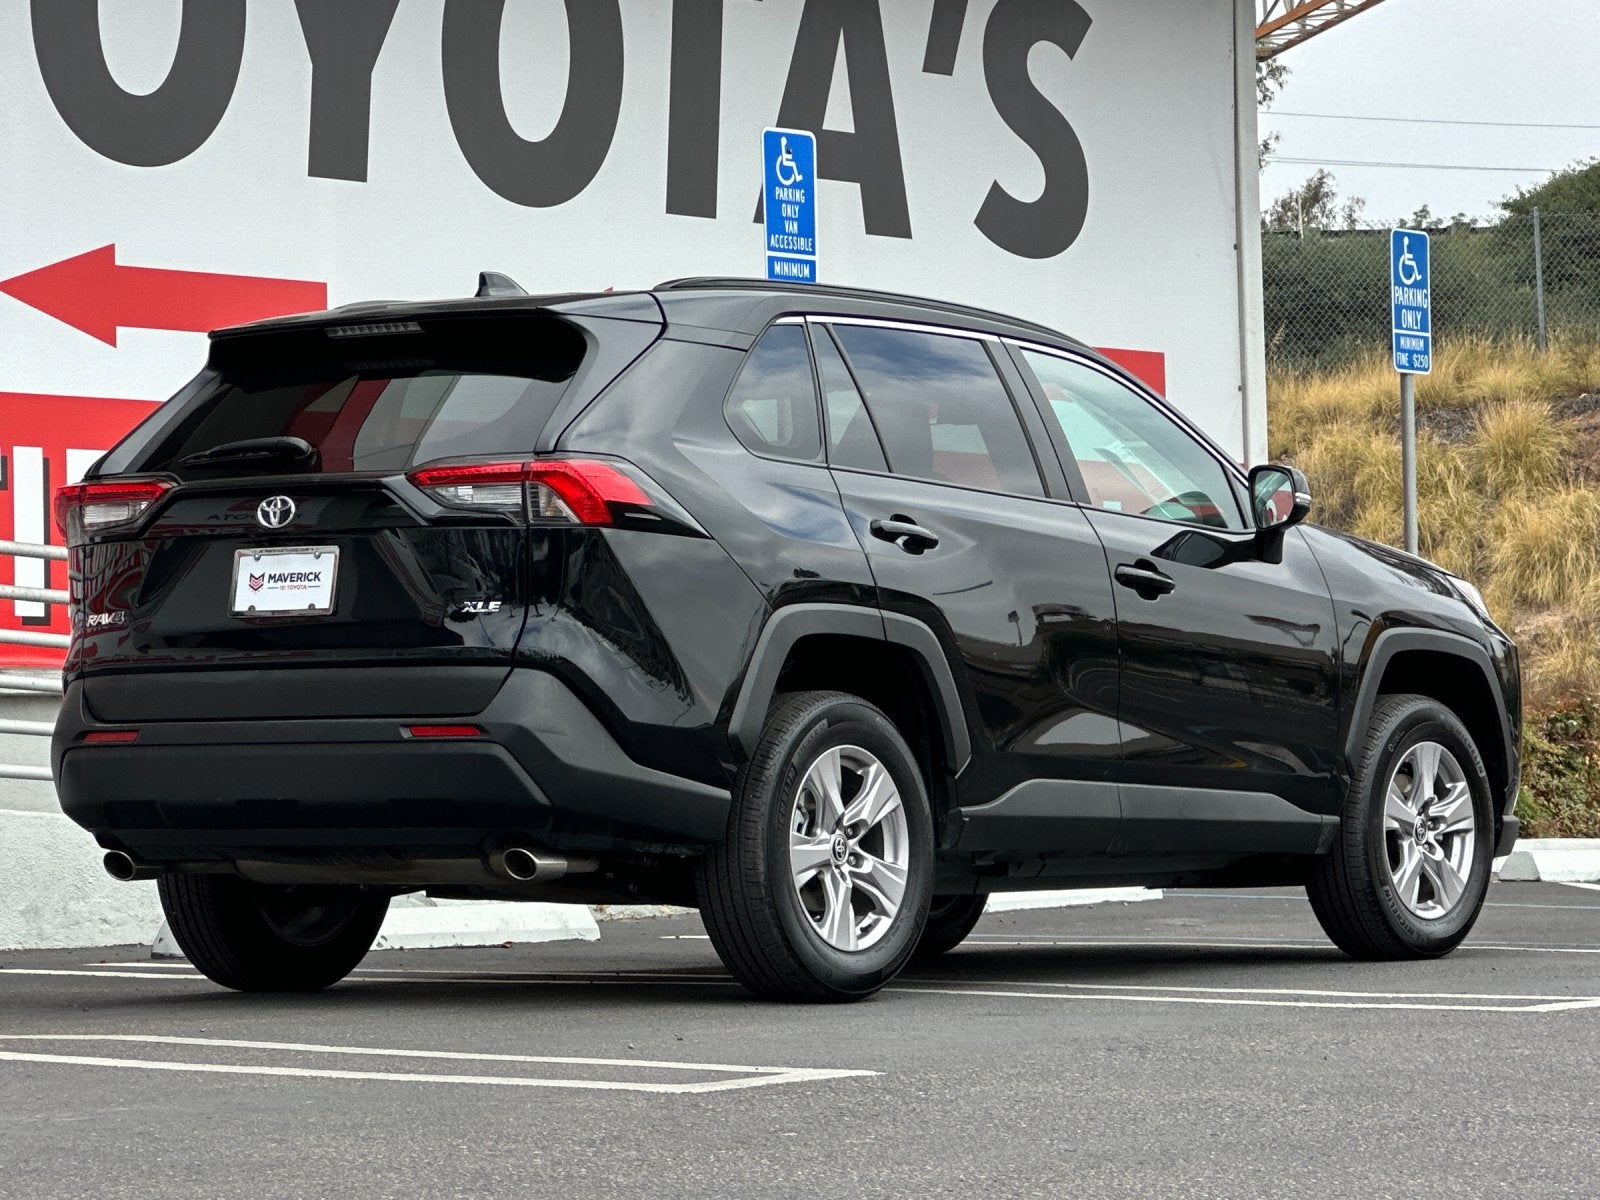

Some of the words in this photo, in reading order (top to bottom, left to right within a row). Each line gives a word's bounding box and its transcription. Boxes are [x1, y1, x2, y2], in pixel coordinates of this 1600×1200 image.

[776, 187, 805, 203] PARKING
[782, 204, 799, 218] ONLY
[784, 221, 798, 234] VAN
[770, 234, 813, 251] ACCESSIBLE
[774, 261, 810, 278] MINIMUM
[1395, 286, 1428, 309] PARKING
[1401, 309, 1422, 330] ONLY
[1400, 336, 1424, 351] MINIMUM
[1397, 352, 1409, 367] FINE
[1412, 354, 1429, 368] $250
[267, 572, 321, 583] MAVERICK
[461, 601, 502, 612] XLE
[86, 610, 125, 627] RAV4
[1383, 888, 1417, 936] MICHELIN
